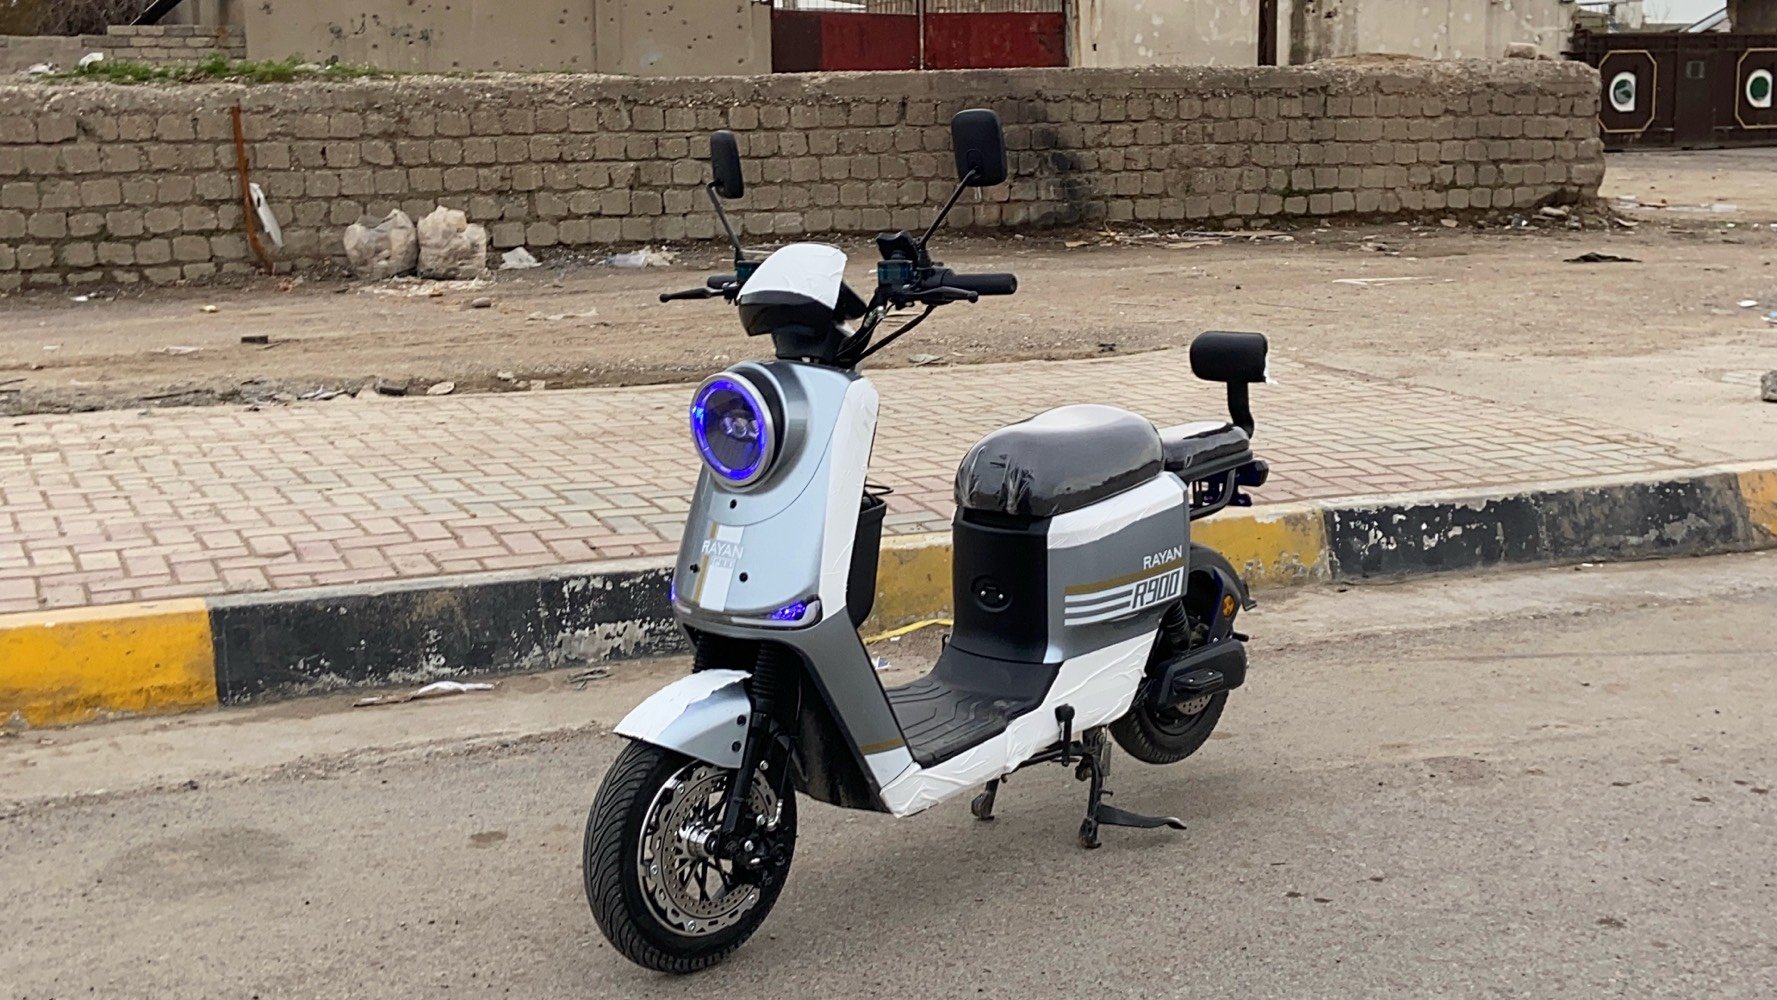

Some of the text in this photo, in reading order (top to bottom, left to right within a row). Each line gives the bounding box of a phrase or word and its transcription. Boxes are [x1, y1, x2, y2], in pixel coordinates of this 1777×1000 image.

[702, 540, 744, 560] RAYAN
[1143, 545, 1183, 569] RAYAN
[1132, 569, 1181, 609] R900
